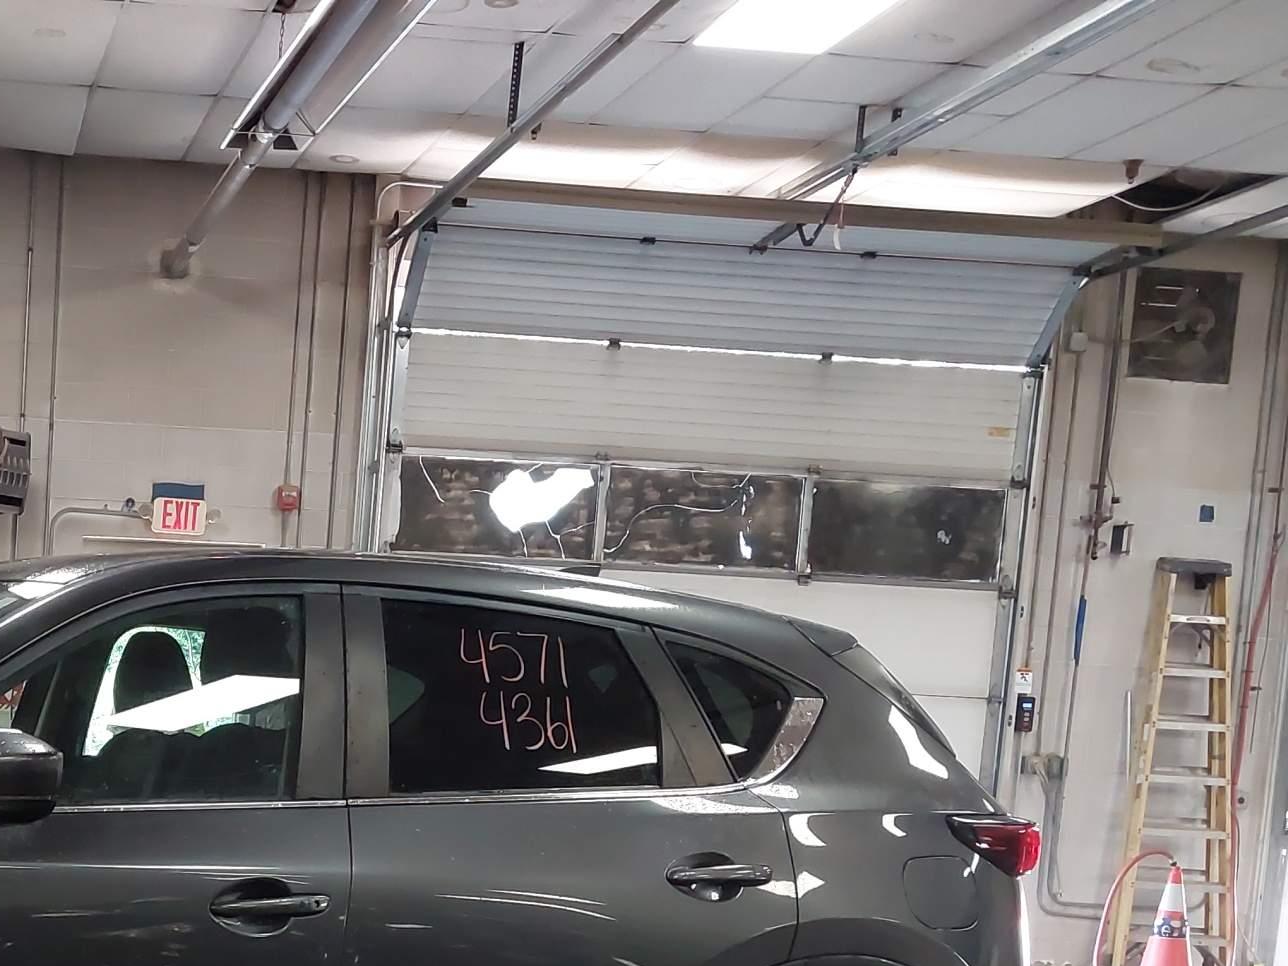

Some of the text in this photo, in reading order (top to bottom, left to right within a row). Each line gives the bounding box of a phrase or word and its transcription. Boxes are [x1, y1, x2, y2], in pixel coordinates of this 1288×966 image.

[162, 500, 200, 530] EXIT
[461, 628, 569, 689] 4571
[480, 690, 577, 754] 4361
